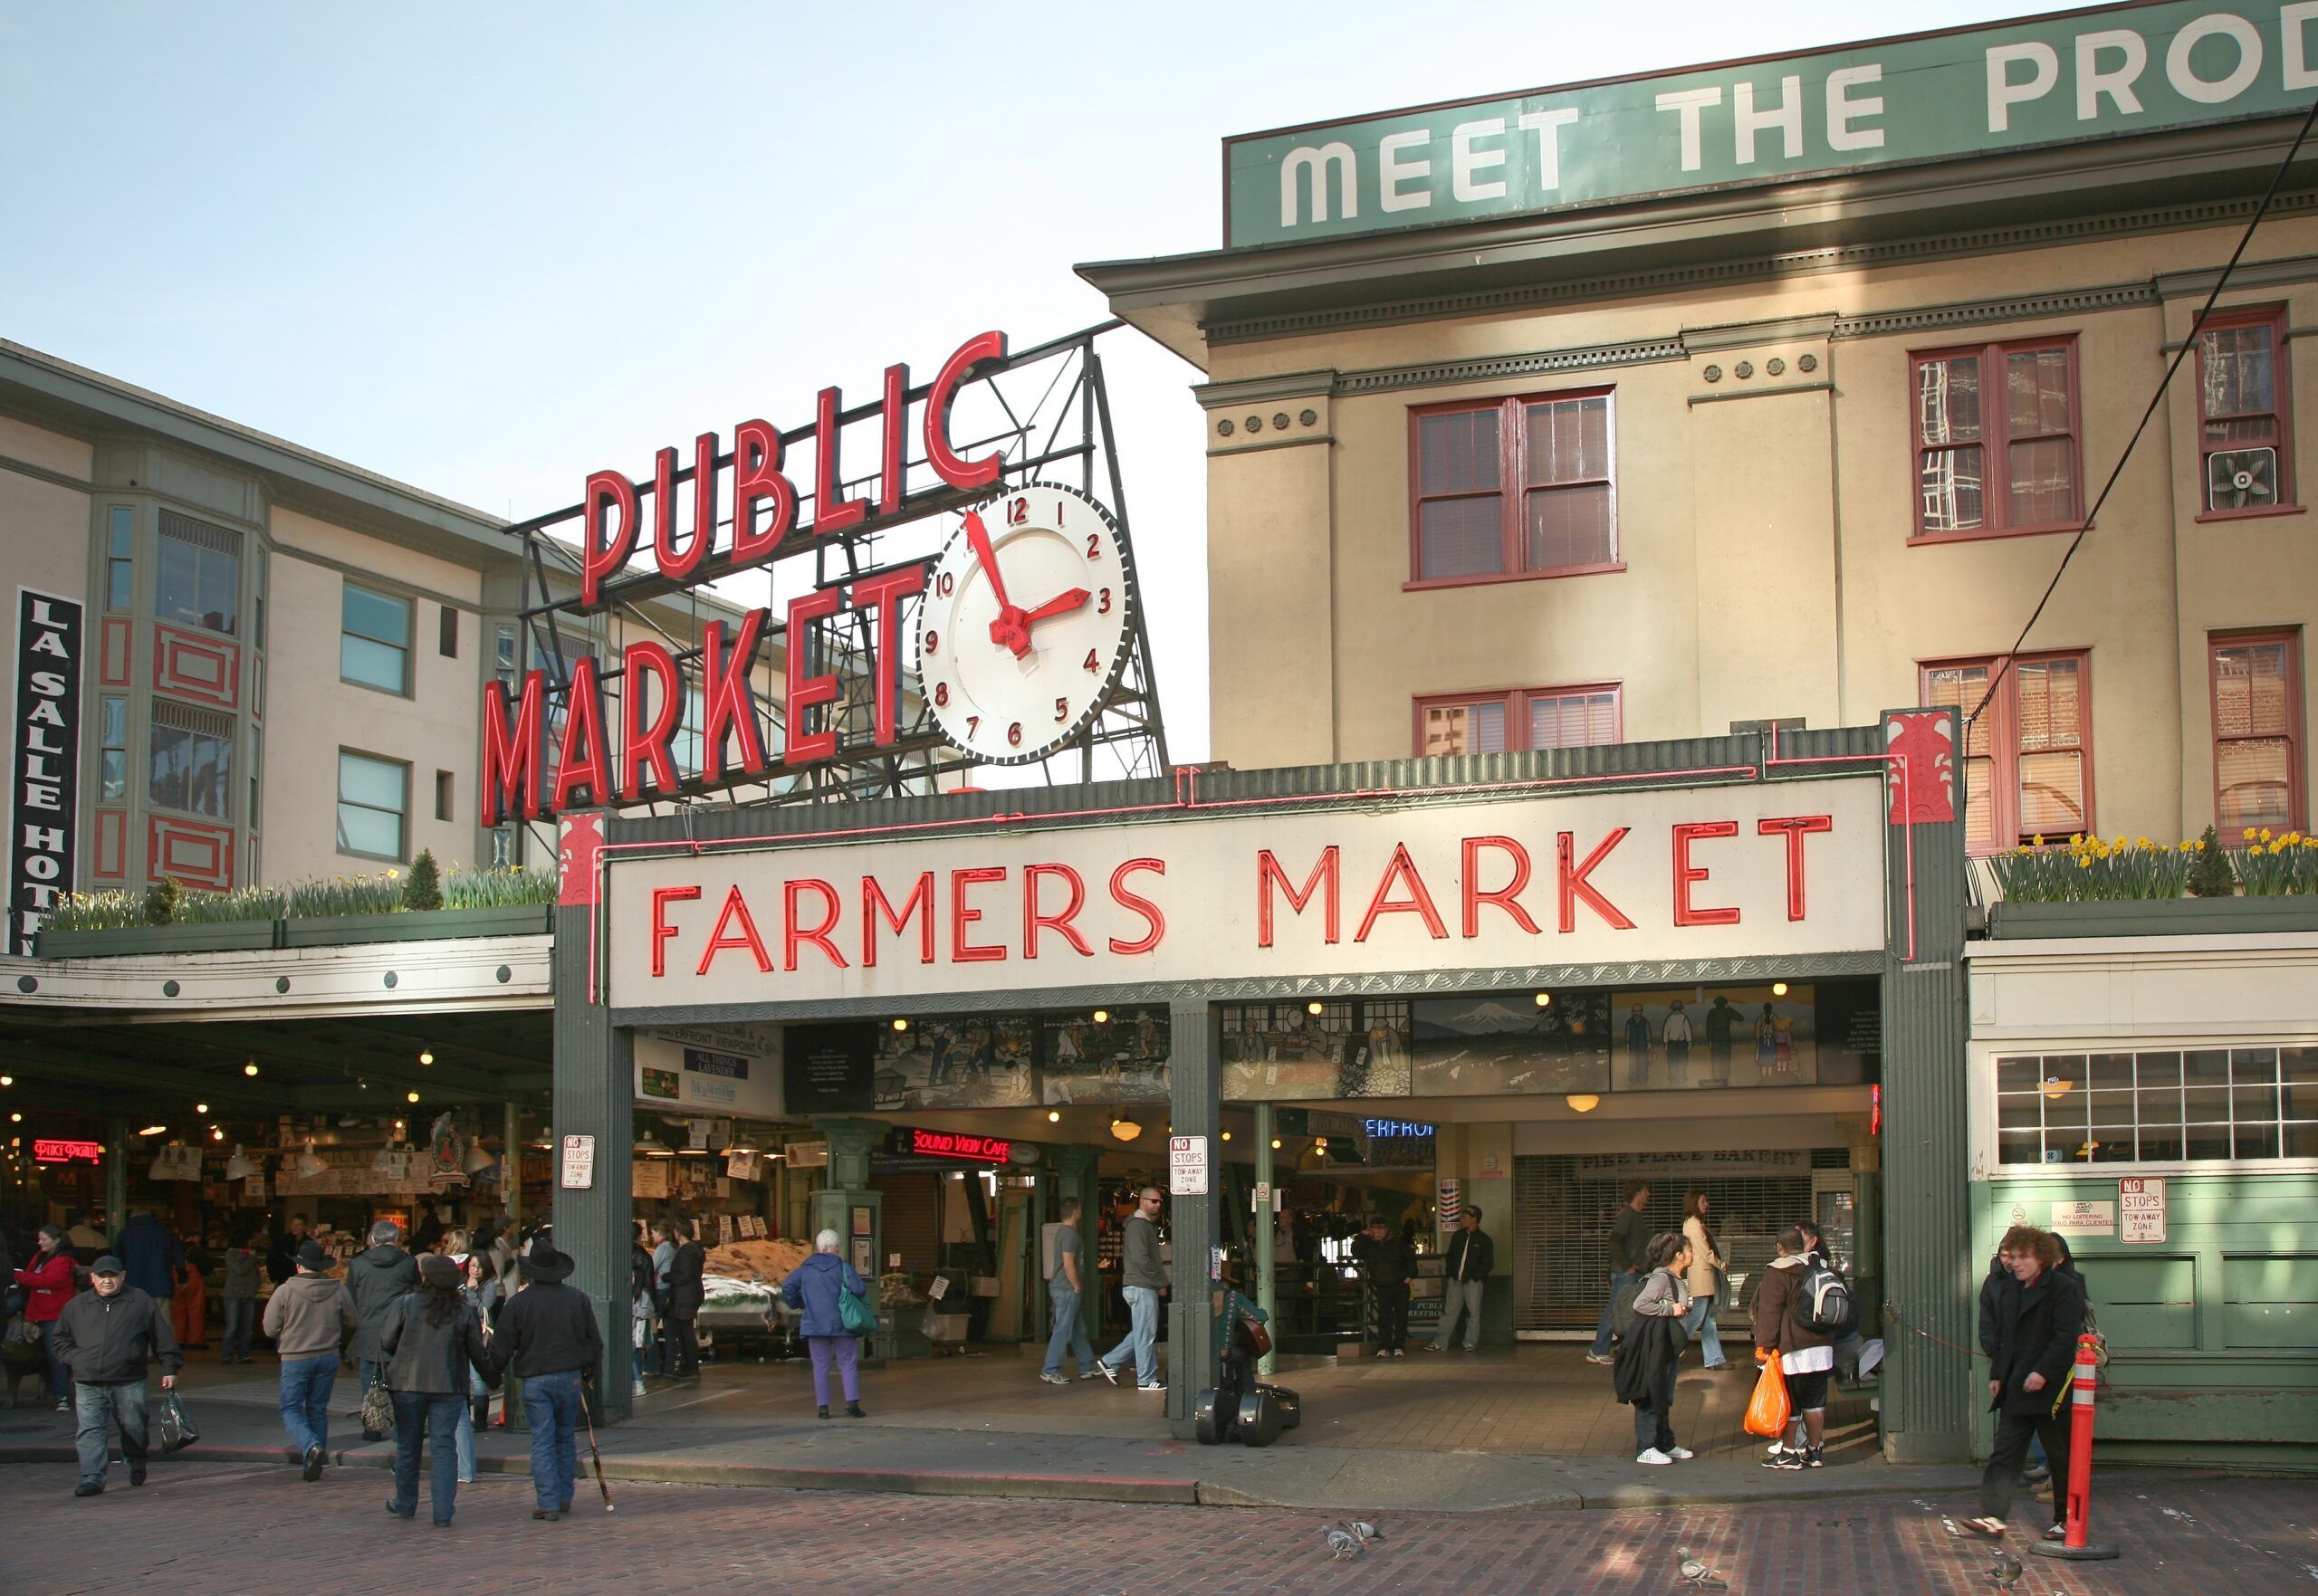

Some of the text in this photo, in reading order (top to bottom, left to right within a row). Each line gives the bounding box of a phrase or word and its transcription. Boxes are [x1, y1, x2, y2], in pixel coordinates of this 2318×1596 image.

[1279, 107, 1578, 228] MEET
[1655, 62, 1885, 171] THE
[580, 330, 1009, 608] PUBLIC
[1007, 497, 1030, 524] 12
[1058, 502, 1064, 526] 1
[1087, 534, 1101, 559] 2
[936, 572, 953, 597] 10
[1097, 588, 1111, 614] 3
[30, 598, 69, 659] LA
[925, 630, 939, 655] 9
[1082, 648, 1101, 673] 4
[480, 561, 932, 828] MARKET
[934, 682, 950, 707] 8
[1054, 697, 1068, 722] 5
[24, 670, 67, 811] SALLE
[966, 715, 980, 741] 7
[1008, 722, 1022, 747] 6
[651, 814, 1832, 978] FARMERS MARKET
[715, 1037, 757, 1053] VIEWPOINT
[696, 1052, 737, 1068] ALL THINGS
[698, 1063, 736, 1077] LAVENDER
[567, 1138, 579, 1147] NO
[567, 1150, 589, 1160] STOPS
[914, 1130, 952, 1151] SOUND
[954, 1134, 981, 1153] VIEW
[983, 1138, 1010, 1156] CAFE
[1173, 1139, 1188, 1151] NO
[1174, 1152, 1202, 1163] STOPS
[2123, 1180, 2141, 1192] NO
[2124, 1195, 2160, 1208] STOPS
[2123, 1213, 2160, 1221] TOW-AWAY
[1417, 1302, 1442, 1310] PUBLI
